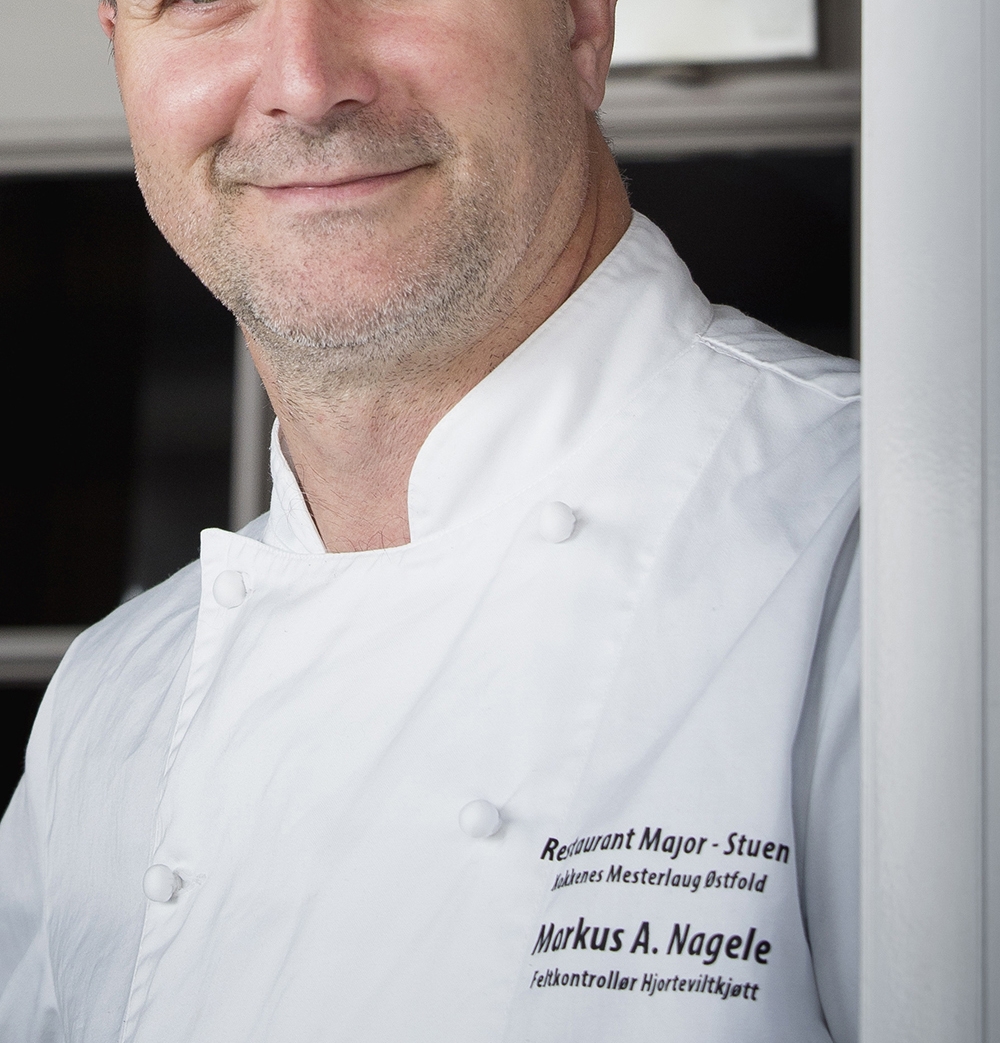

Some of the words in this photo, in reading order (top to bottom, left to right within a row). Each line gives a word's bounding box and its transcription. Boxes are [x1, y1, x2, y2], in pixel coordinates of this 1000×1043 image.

[540, 828, 635, 861] Restaurant
[638, 827, 707, 860] Major
[723, 832, 790, 864] Stuen
[606, 864, 702, 893] Mesterlaug
[704, 870, 768, 893] Østfold
[531, 917, 625, 956] Markus
[629, 921, 658, 954] A.
[666, 923, 772, 965] Nagele
[530, 968, 638, 991] Feltkontrollør
[640, 973, 760, 1001] Hjorteviltkjøtt
